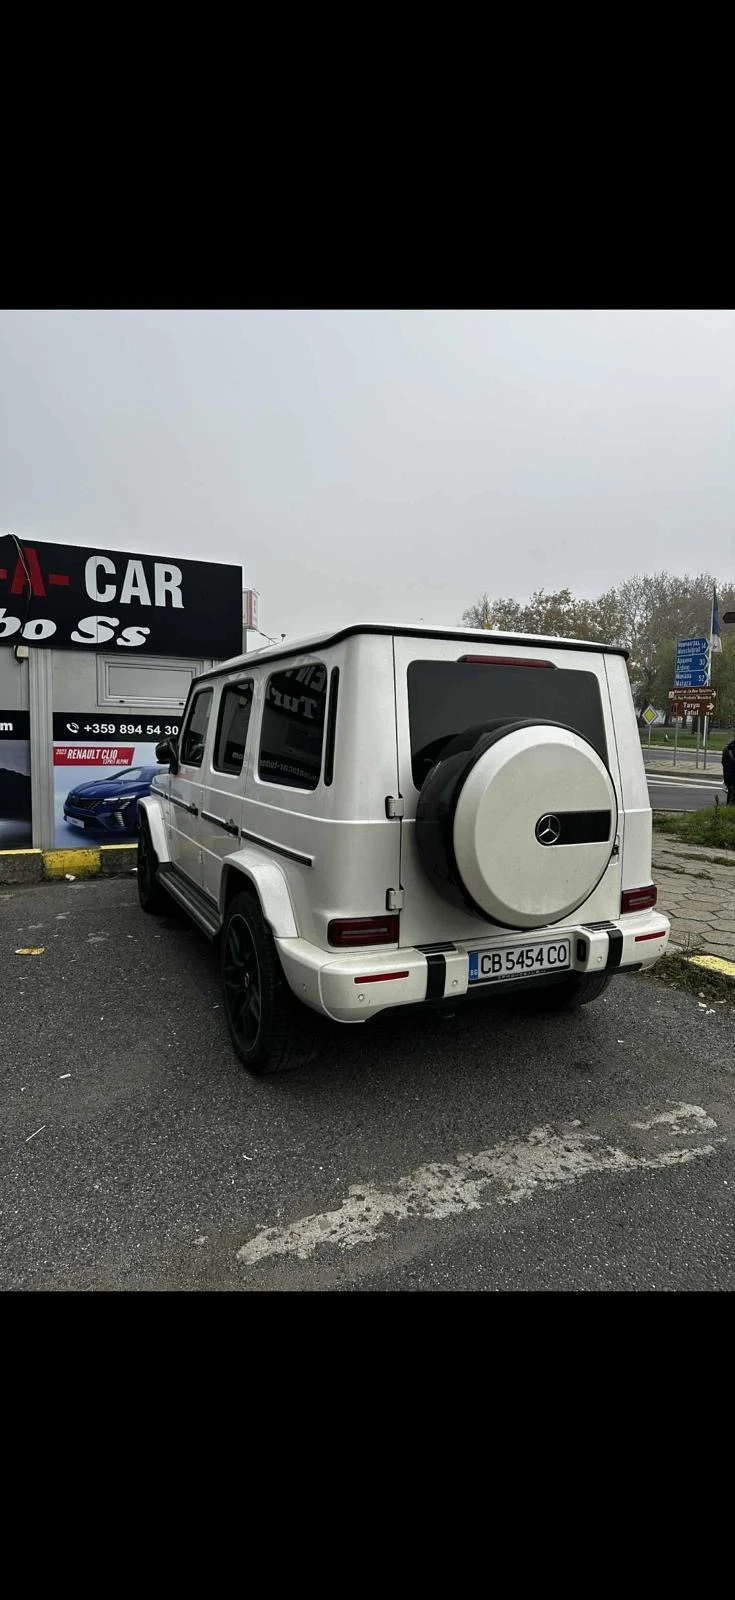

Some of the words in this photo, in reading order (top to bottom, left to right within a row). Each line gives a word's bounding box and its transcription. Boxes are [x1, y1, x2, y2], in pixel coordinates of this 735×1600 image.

[85, 555, 184, 609] CAR
[84, 724, 116, 734] +359
[119, 725, 142, 735] 894
[146, 725, 161, 735] 54
[164, 726, 179, 735] 30
[67, 749, 101, 760] RENAULT
[101, 750, 118, 760] CLIO
[481, 953, 502, 974] CB
[506, 947, 544, 970] 5454
[547, 944, 567, 964] CO
